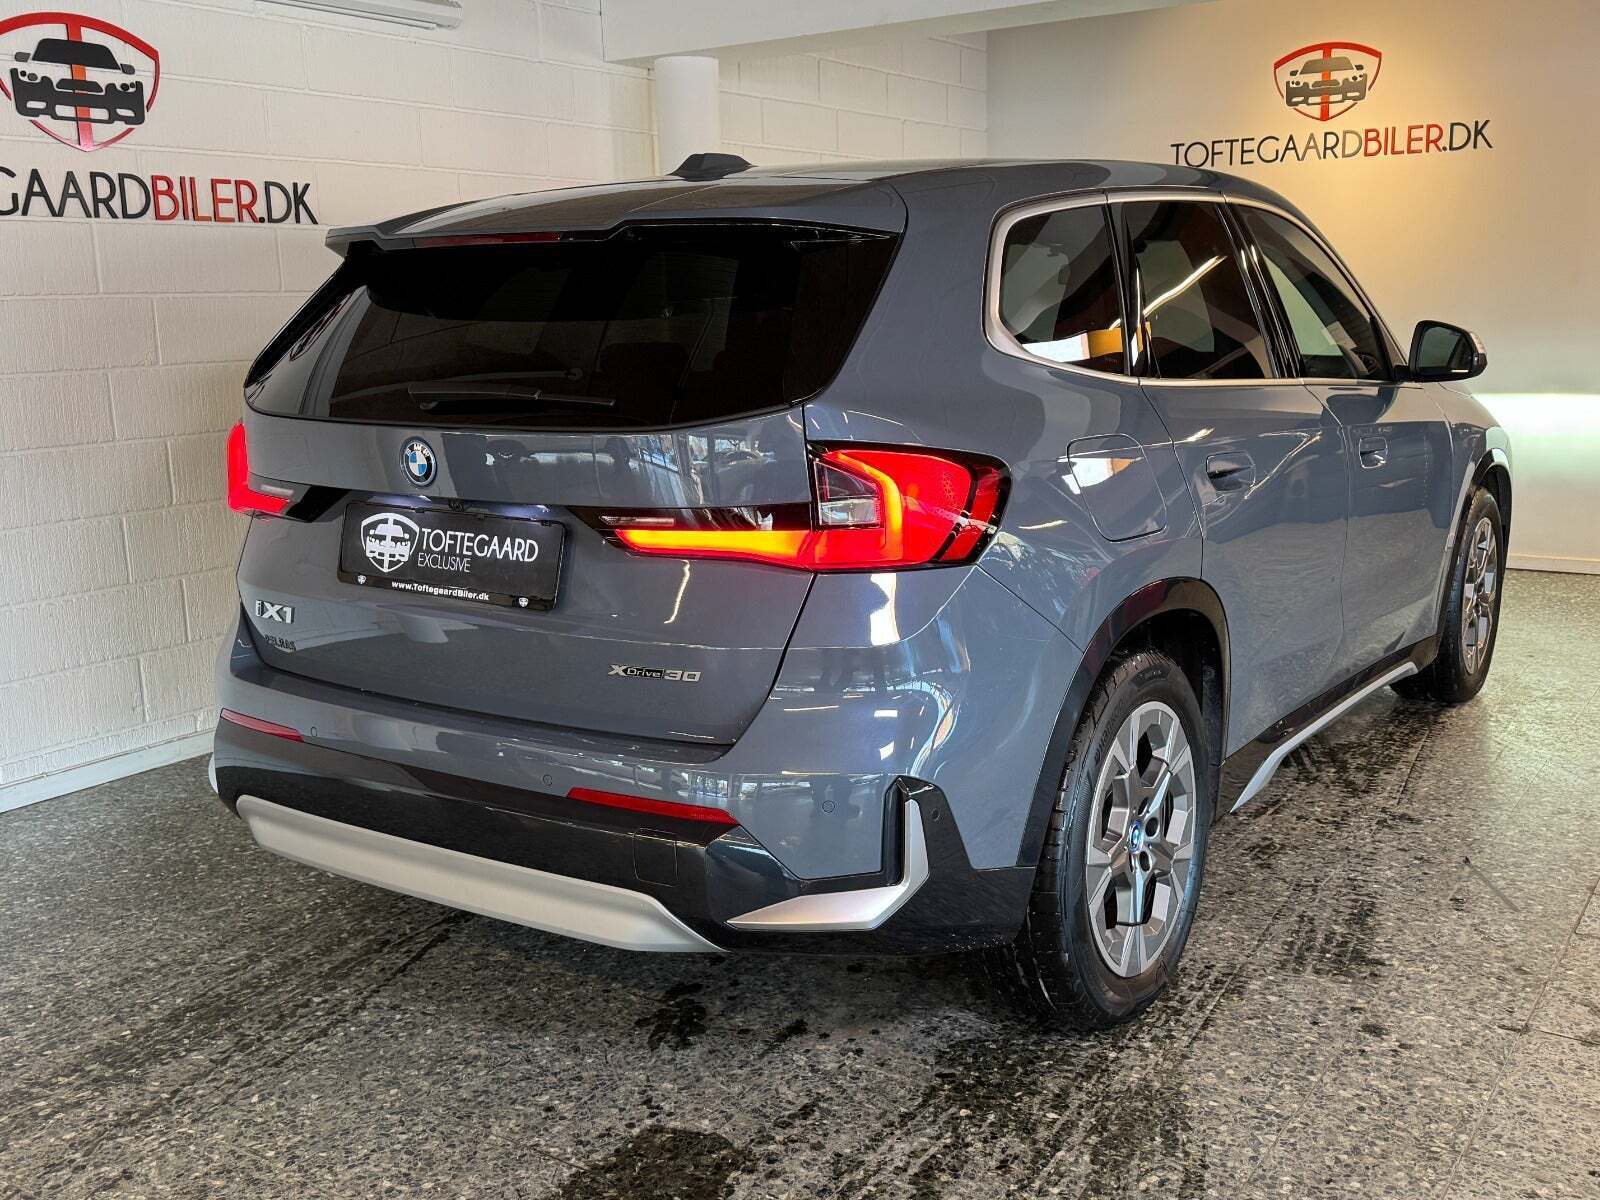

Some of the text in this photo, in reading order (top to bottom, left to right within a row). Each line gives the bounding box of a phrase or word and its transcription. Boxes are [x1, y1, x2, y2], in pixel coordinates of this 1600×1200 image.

[1170, 119, 1493, 167] TOFTEGAARDBILER.DK
[421, 527, 539, 563] TOFTEGAARD
[417, 552, 471, 573] EXCLUSIVE
[391, 581, 490, 601] www.ToftegaardBiler.dk
[255, 600, 294, 624] iX1
